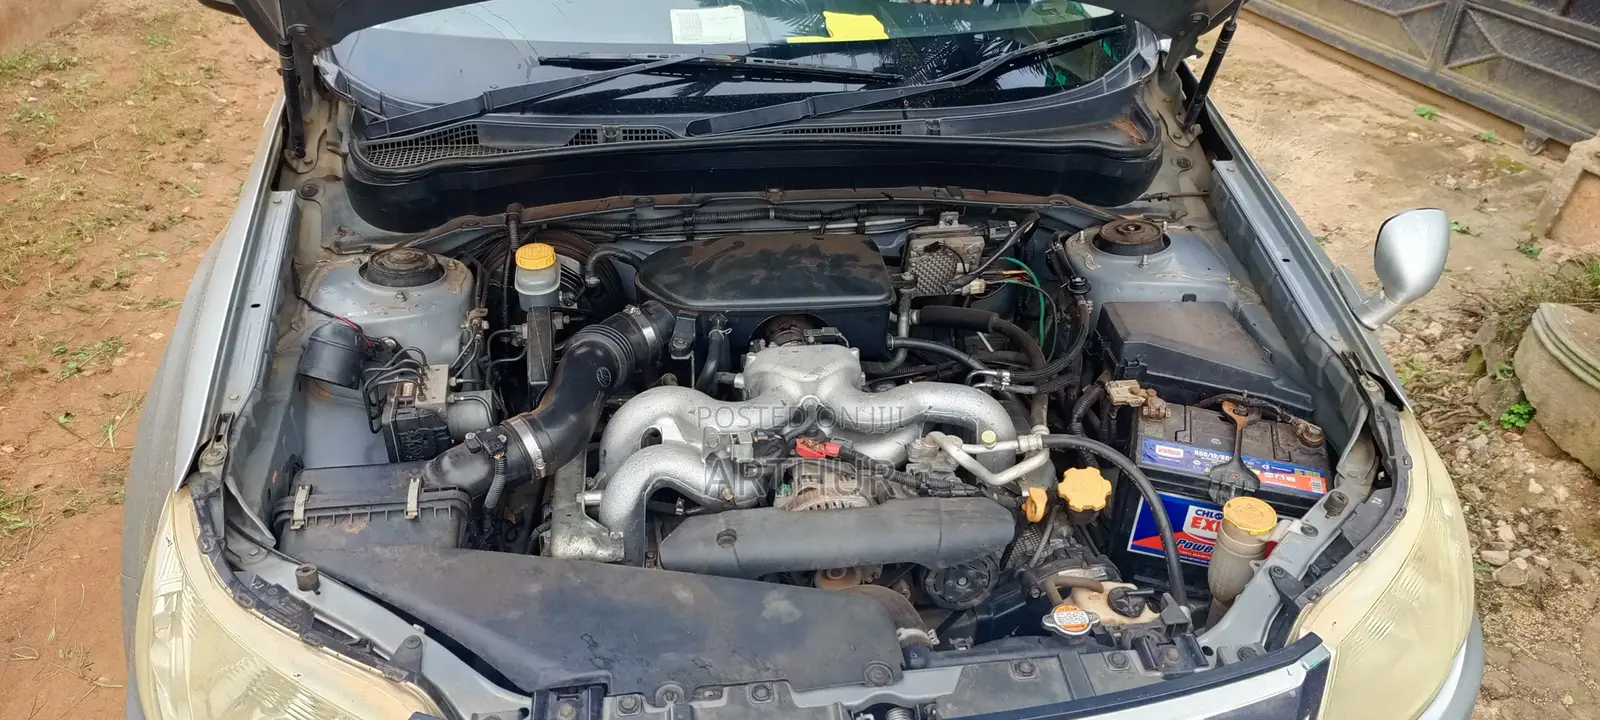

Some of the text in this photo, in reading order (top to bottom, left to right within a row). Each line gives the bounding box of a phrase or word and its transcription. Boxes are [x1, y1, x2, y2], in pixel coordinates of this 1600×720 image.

[1195, 509, 1223, 520] CHLO
[1191, 516, 1221, 532] EXI
[1176, 538, 1215, 553] Powe
